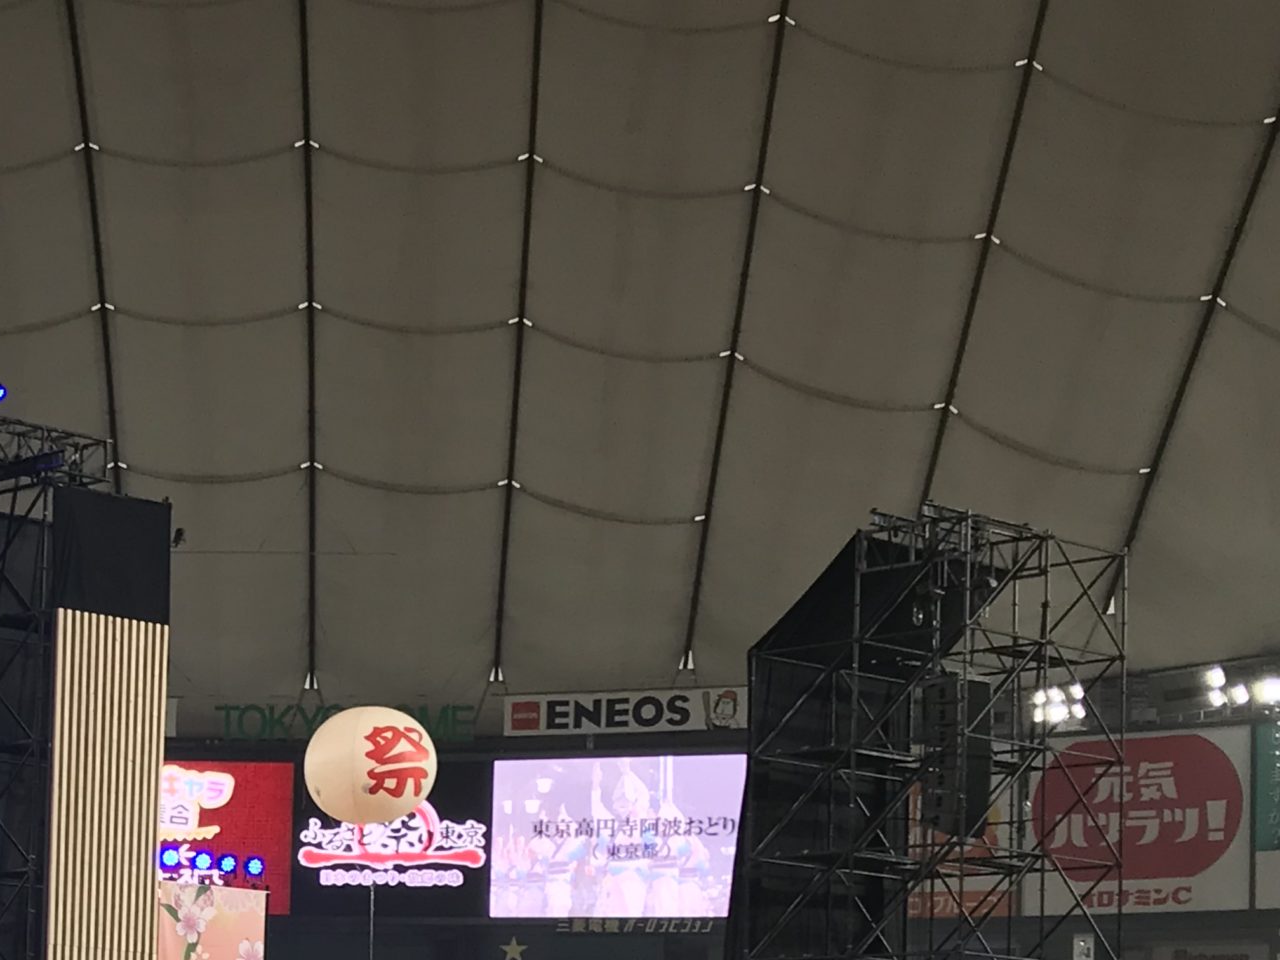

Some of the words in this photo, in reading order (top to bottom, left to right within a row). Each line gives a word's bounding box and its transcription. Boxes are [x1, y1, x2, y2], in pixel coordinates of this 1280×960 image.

[546, 695, 691, 730] ENEOS
[364, 725, 430, 798] 祭
[1092, 761, 1179, 804] 元気
[531, 816, 737, 838] 東京高円寺阿波おどり
